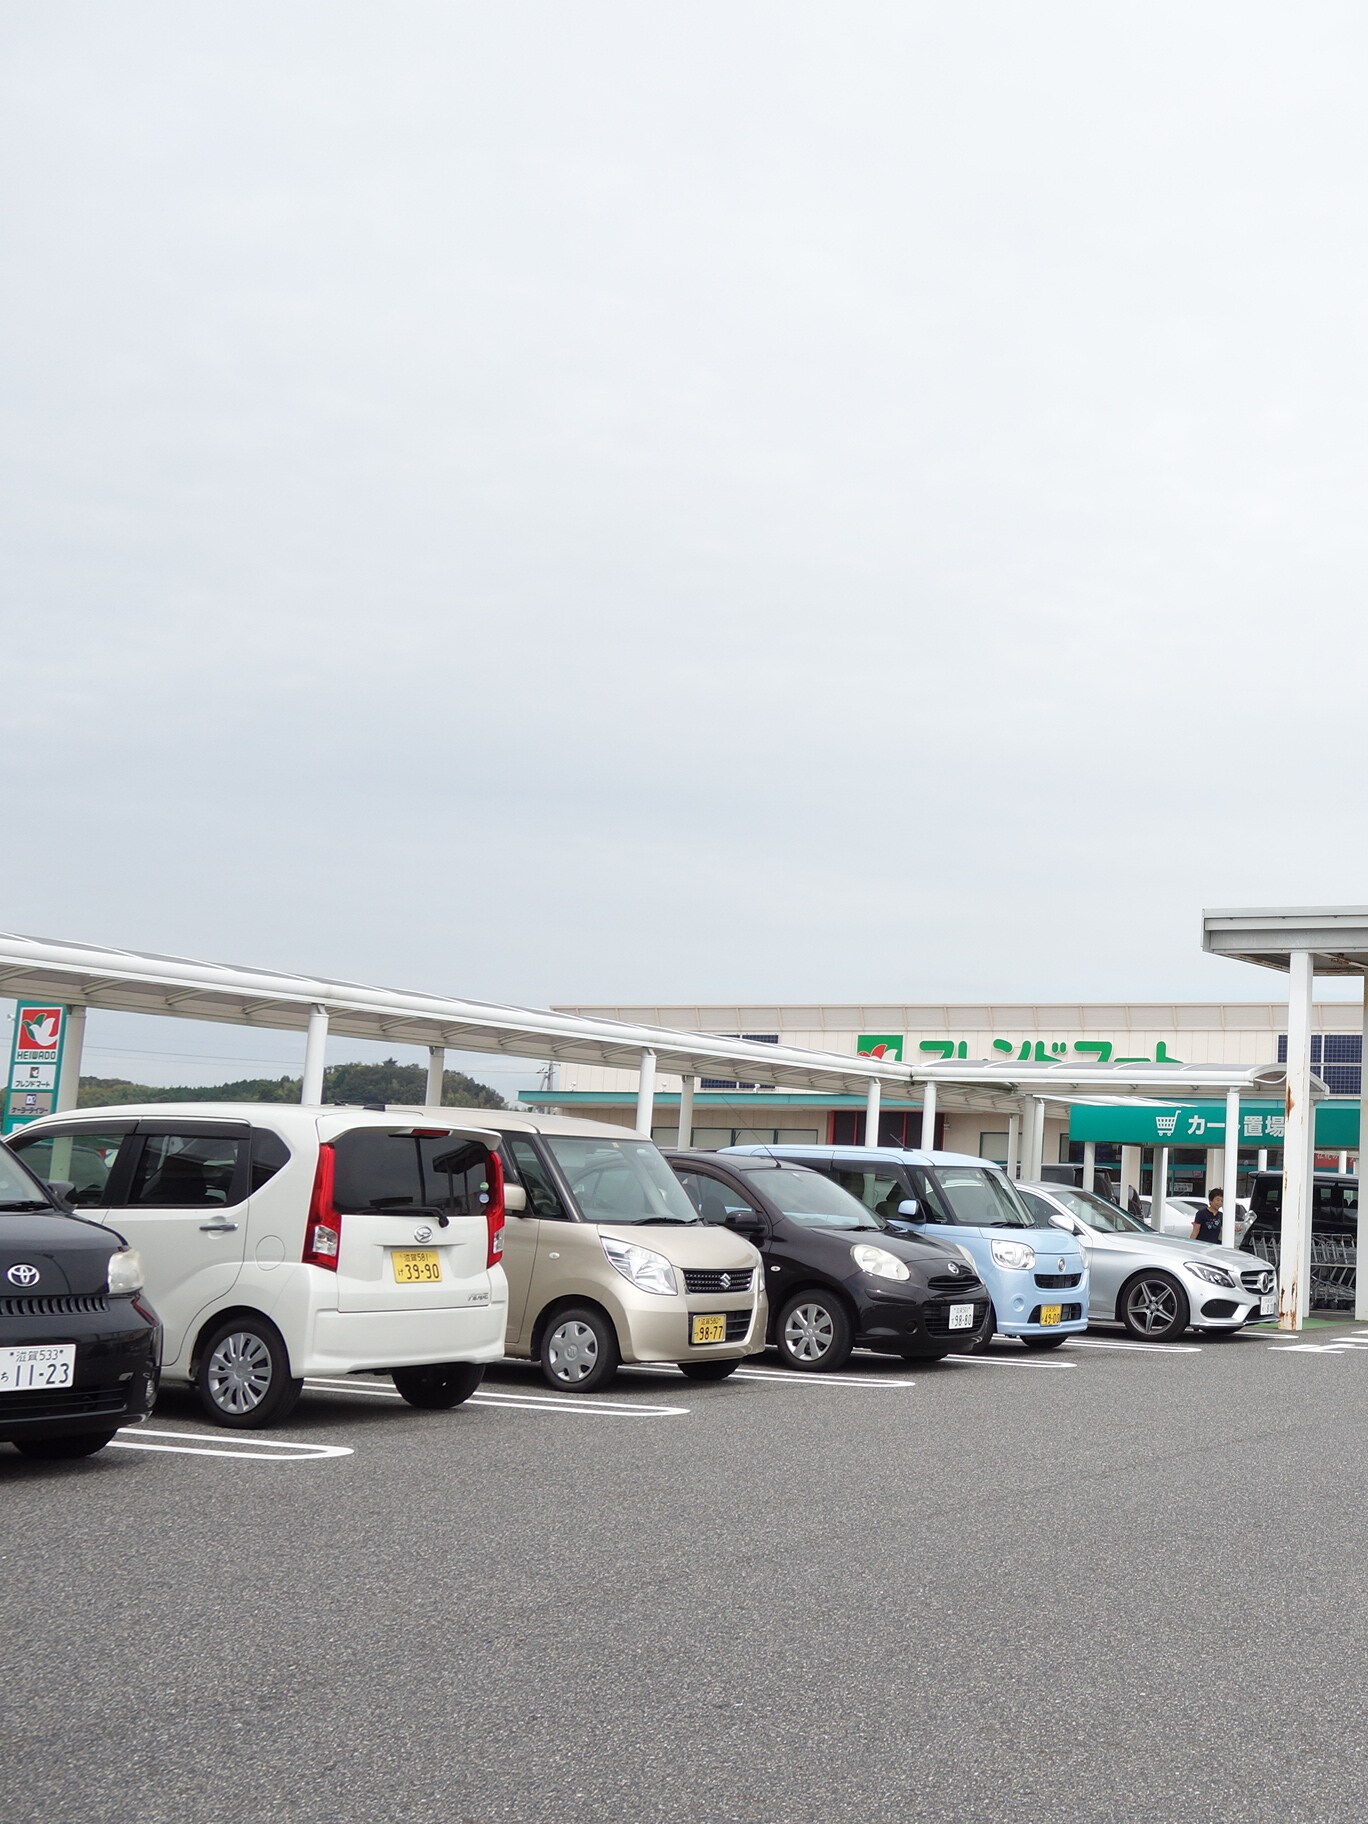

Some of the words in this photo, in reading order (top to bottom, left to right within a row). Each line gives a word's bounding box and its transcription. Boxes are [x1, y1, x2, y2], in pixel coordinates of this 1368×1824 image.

[16, 1051, 57, 1060] HEIWADO
[15, 1080, 51, 1088] フレンドマート
[1187, 1115, 1285, 1137] カー置場
[405, 1263, 440, 1280] 39-90
[699, 1325, 723, 1341] 98-77
[16, 1350, 58, 1362] 滋賀533
[1, 1372, 9, 1383] ち
[16, 1363, 70, 1387] 11-23
